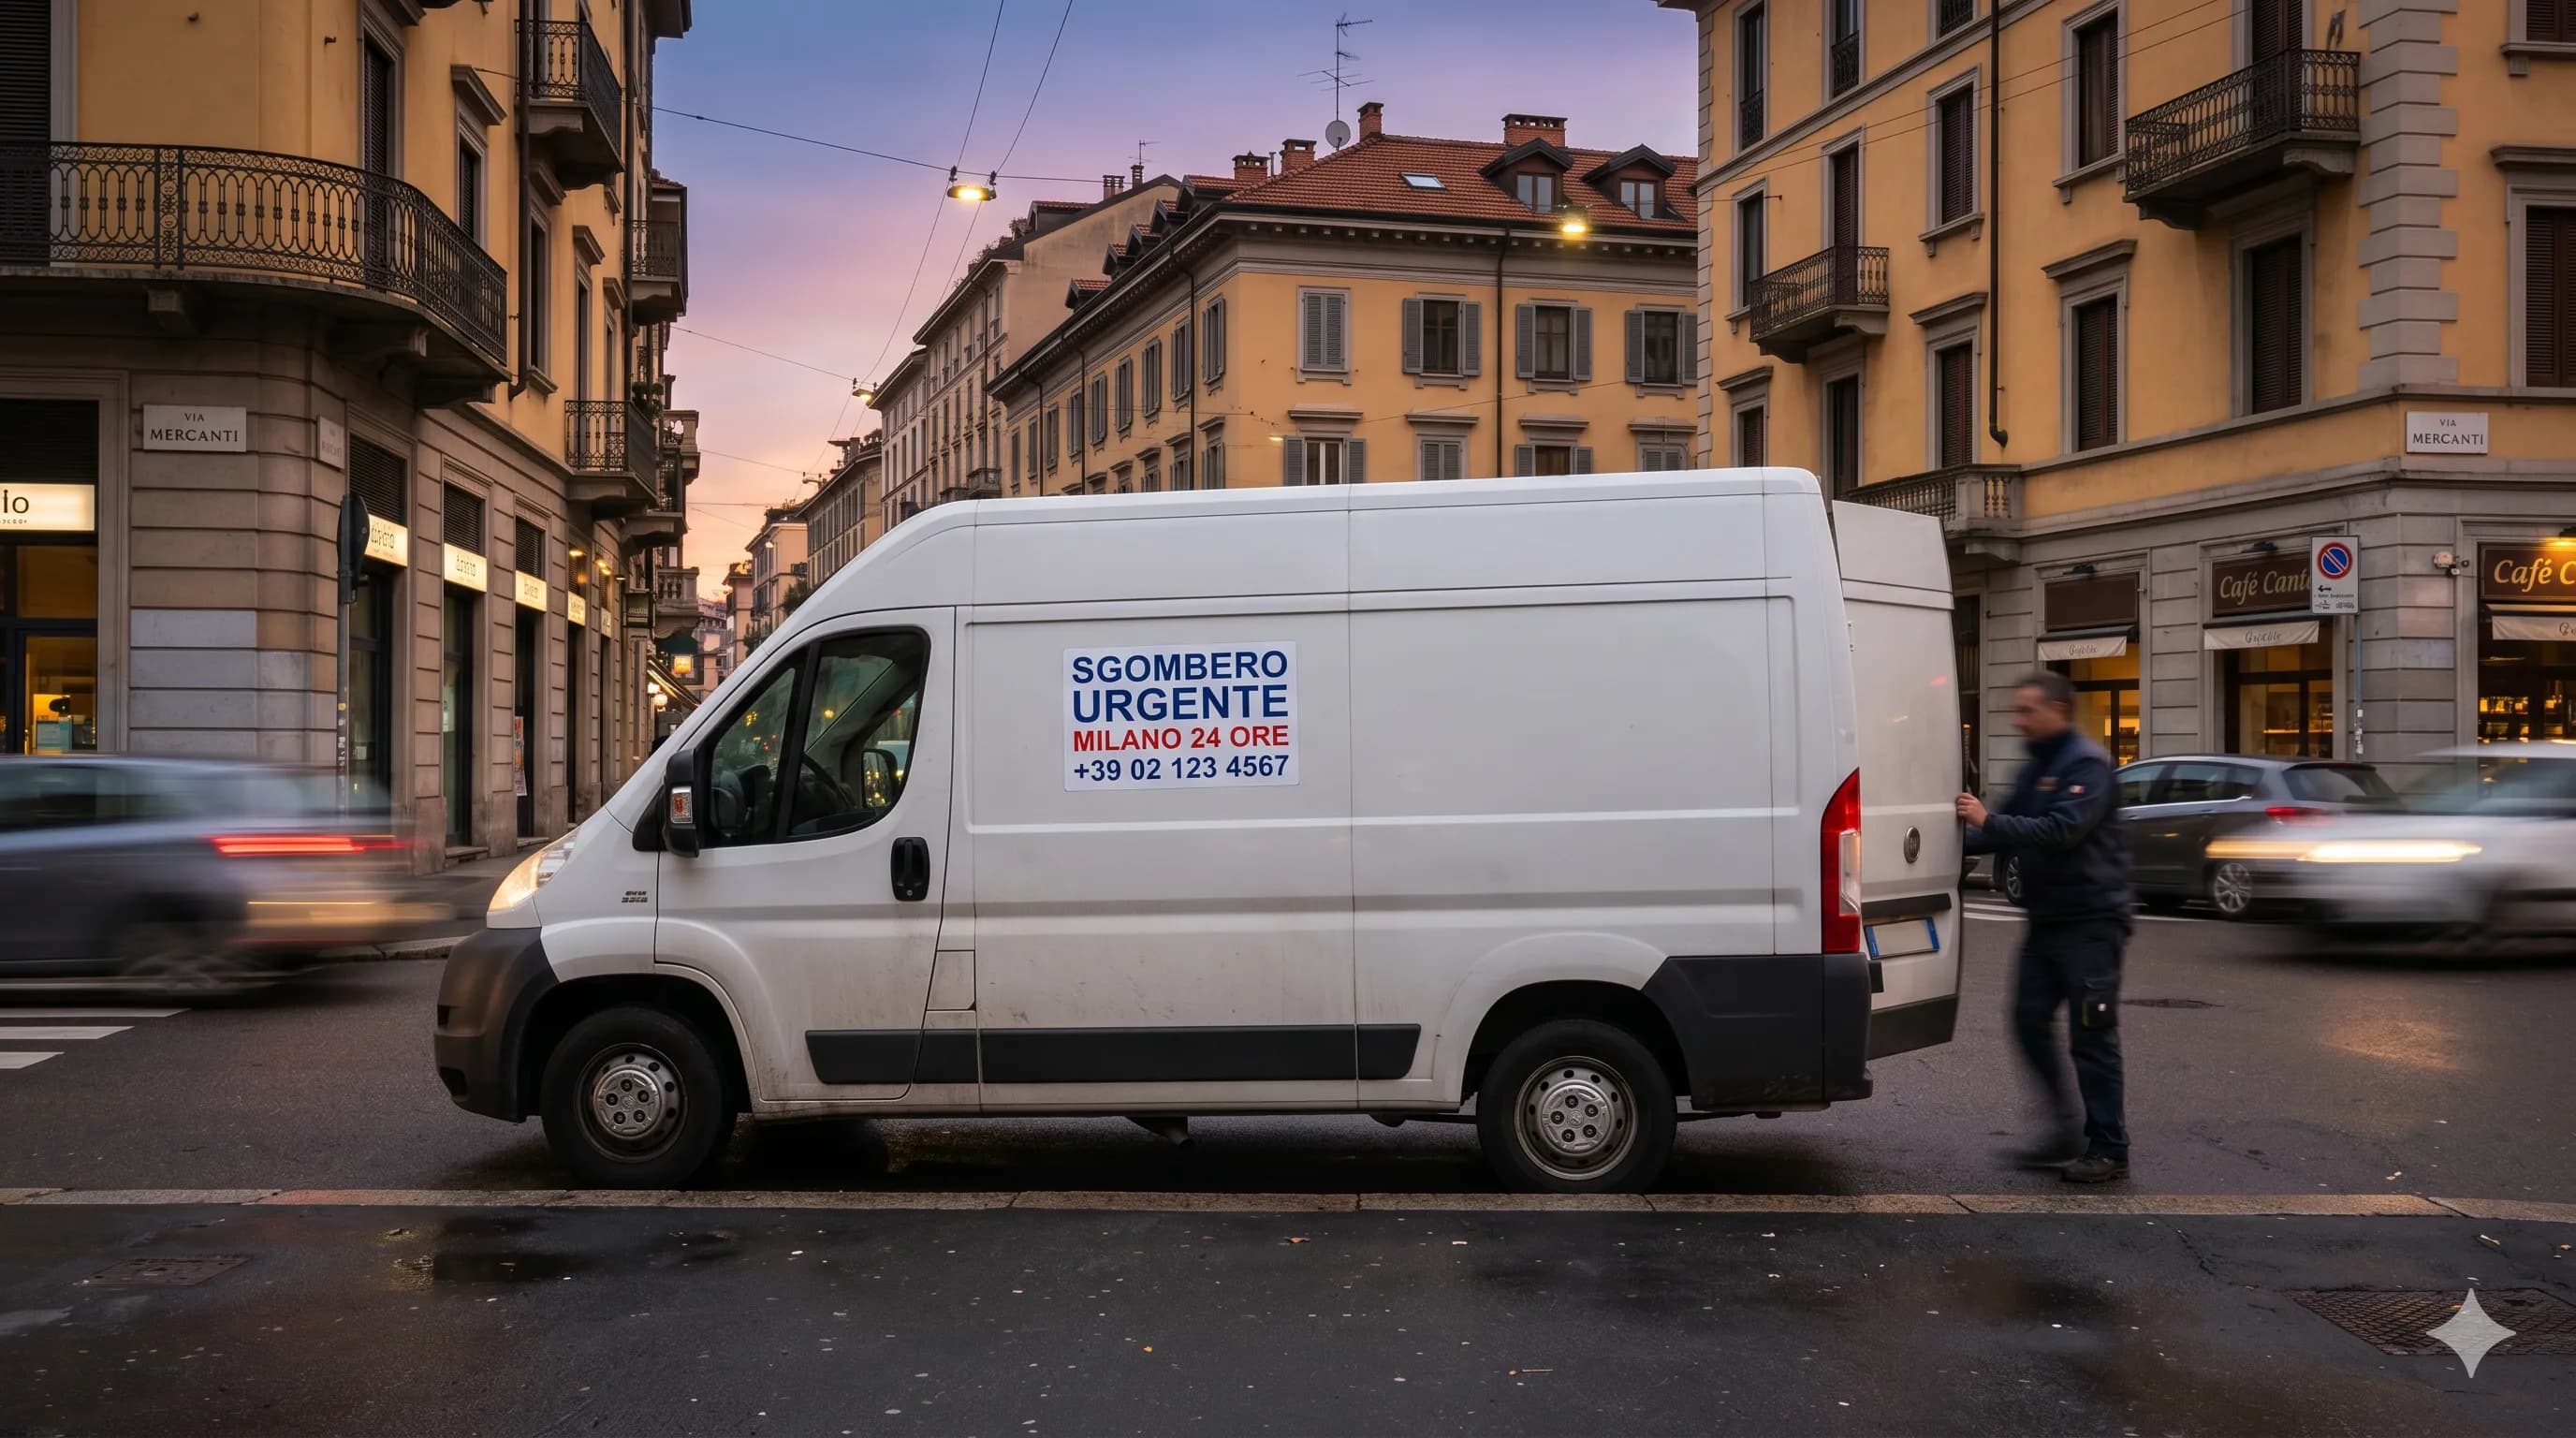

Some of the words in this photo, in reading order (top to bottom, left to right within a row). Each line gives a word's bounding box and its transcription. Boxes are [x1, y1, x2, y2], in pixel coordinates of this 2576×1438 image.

[184, 413, 204, 422] VIA
[151, 429, 238, 442] MERCANTI
[2412, 433, 2483, 445] MERCANTI
[2219, 570, 2259, 606] Café
[2494, 558, 2553, 593] Café
[1072, 651, 1288, 683] SGOMBERO
[1073, 684, 1288, 723] URGENTE
[1074, 728, 1181, 752] MILANO
[1191, 726, 1221, 748] 24
[1230, 726, 1289, 747] ORE
[1074, 759, 1121, 781] +39
[1131, 758, 1161, 780] 02
[1171, 756, 1217, 779] 123
[1226, 755, 1289, 777] 4567
